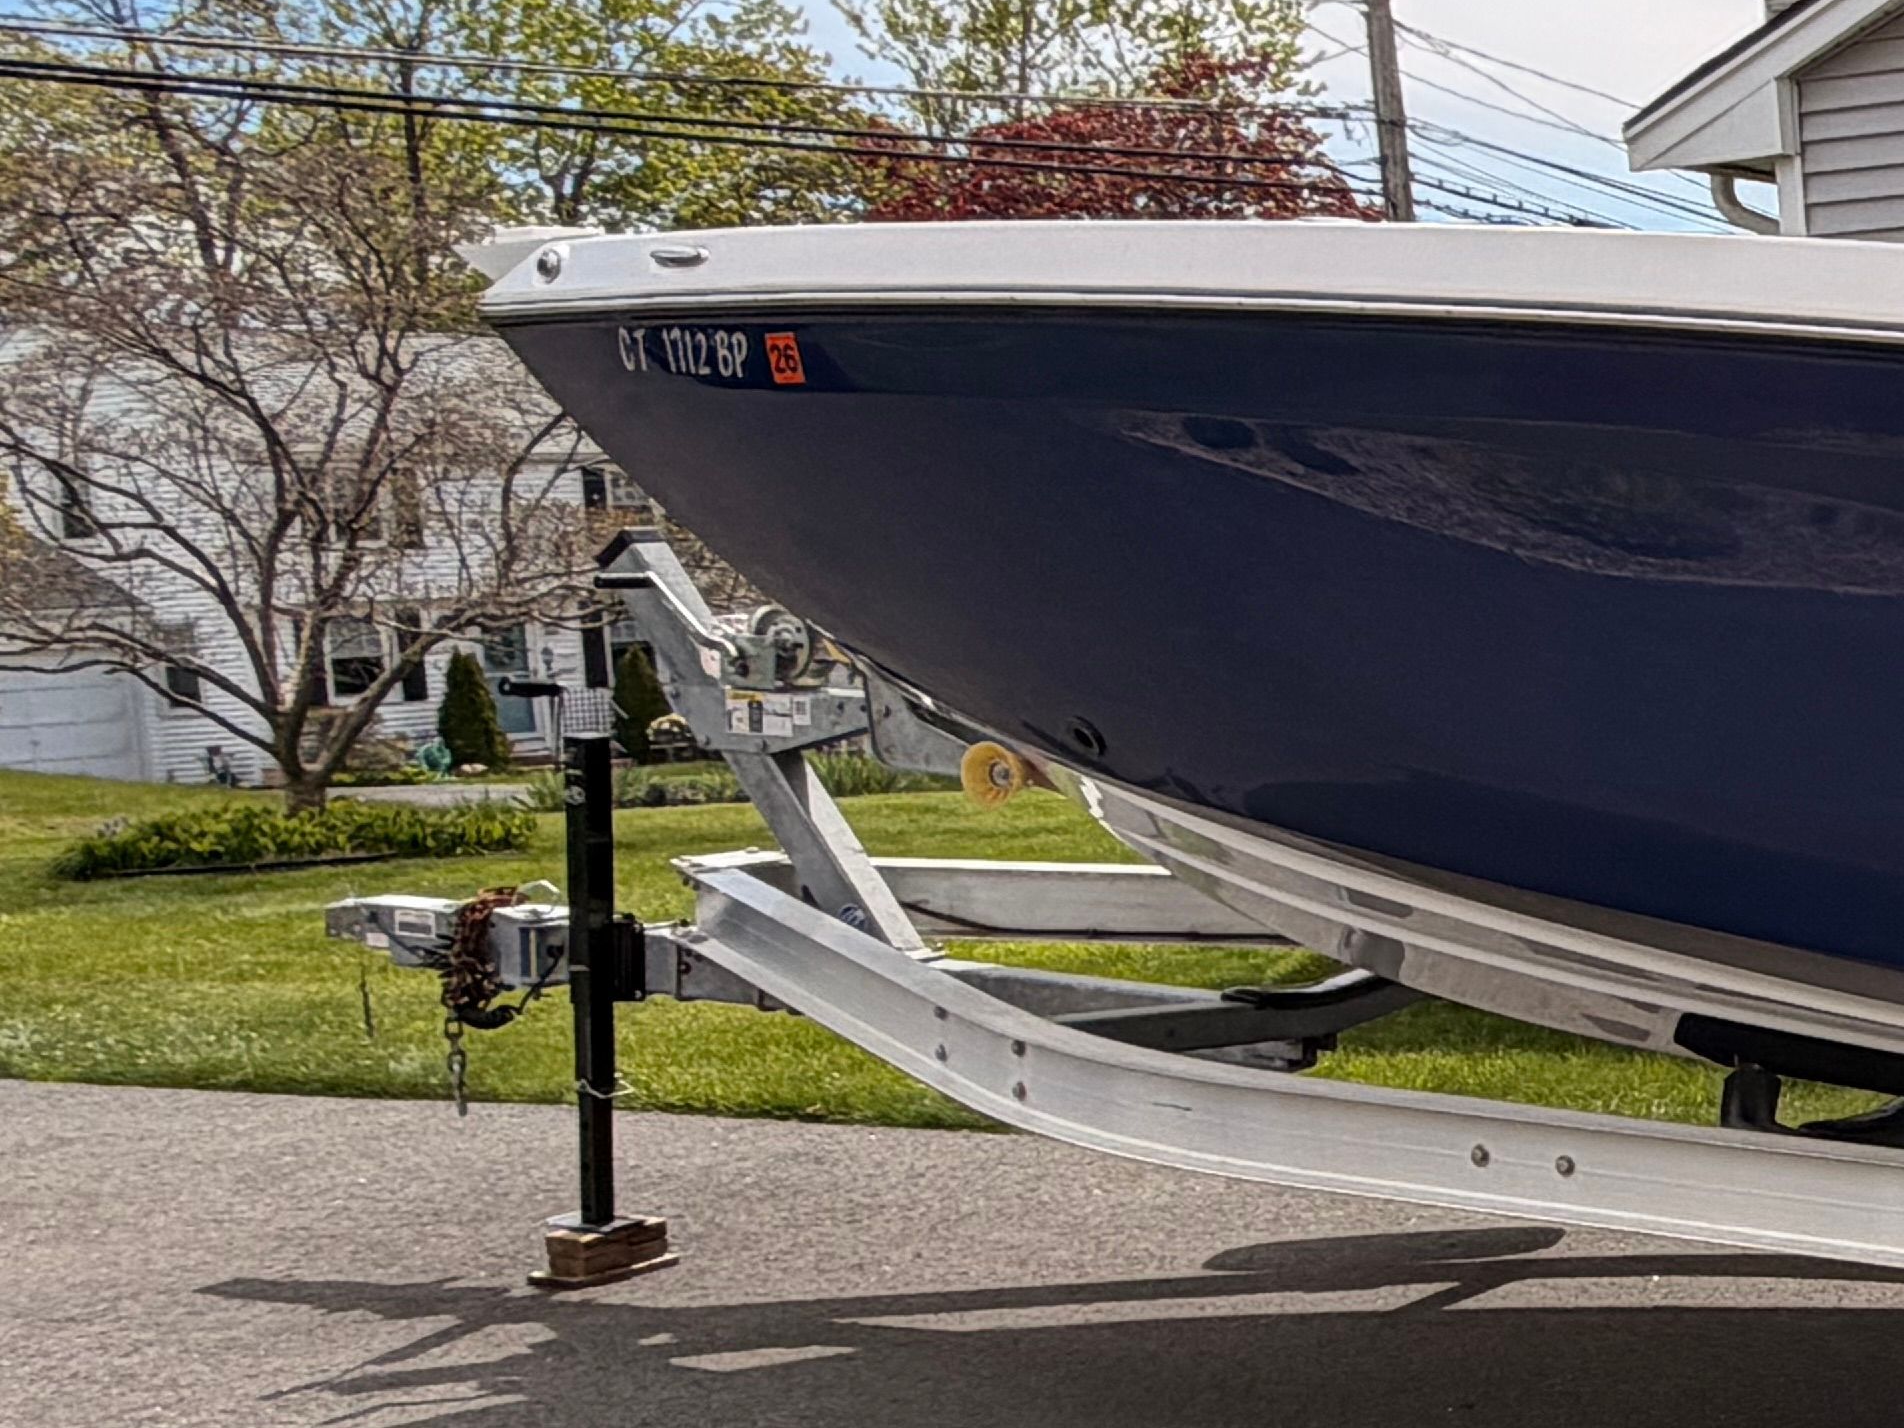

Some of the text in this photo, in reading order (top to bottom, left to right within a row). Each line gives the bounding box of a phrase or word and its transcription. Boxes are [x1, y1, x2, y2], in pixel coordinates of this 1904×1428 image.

[618, 327, 748, 378] CT 1712 BP
[768, 343, 798, 374] 26
